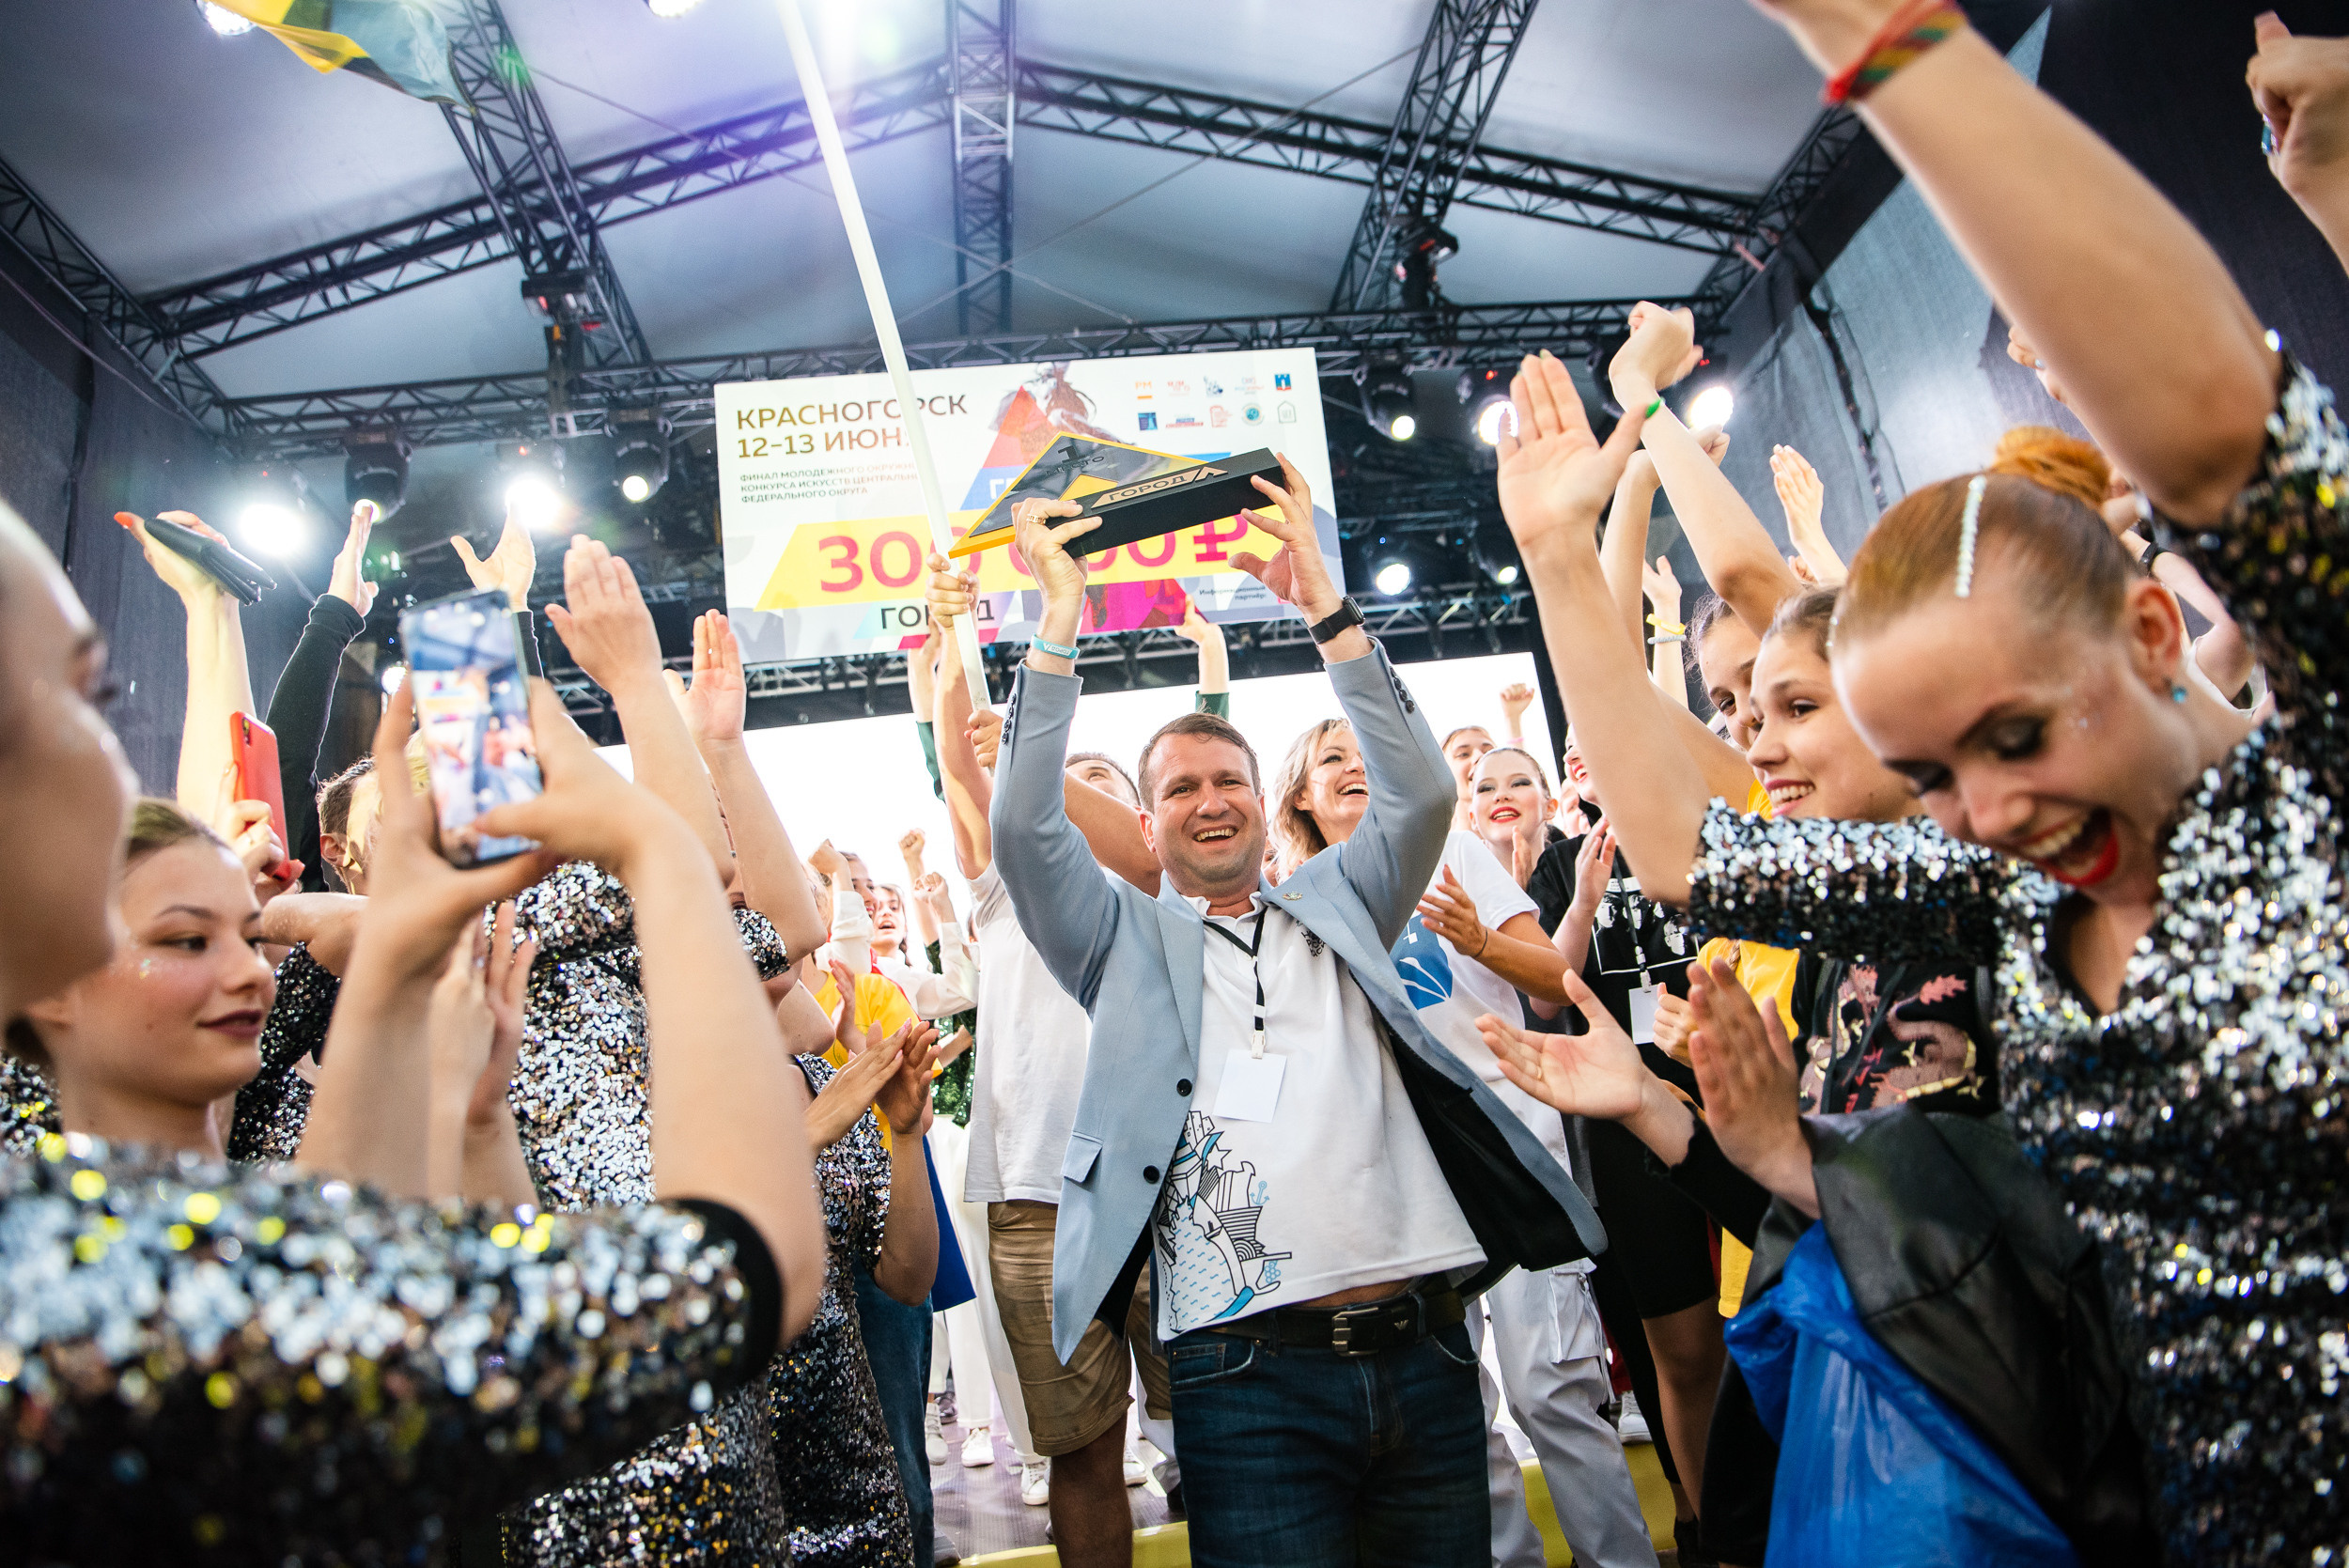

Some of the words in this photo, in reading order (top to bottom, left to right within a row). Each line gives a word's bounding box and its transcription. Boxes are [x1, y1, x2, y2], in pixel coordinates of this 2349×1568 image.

[738, 434, 815, 458] 12-13
[824, 427, 910, 452] ИЮН
[740, 472, 778, 482] ФИНАЛ
[781, 465, 864, 479] МОЛОДЕЖНОГО
[868, 462, 914, 474] ОКРУЖН
[1046, 457, 1104, 476] МСТО
[740, 480, 797, 492] КОНКУРСА
[799, 477, 851, 489] ИСКУССТВ
[1109, 475, 1187, 501] ГОРОД
[741, 489, 826, 504] ФЕДЕРАЛЬНОГО
[829, 487, 868, 497] ОКРУГА
[880, 598, 995, 629] ГОД
